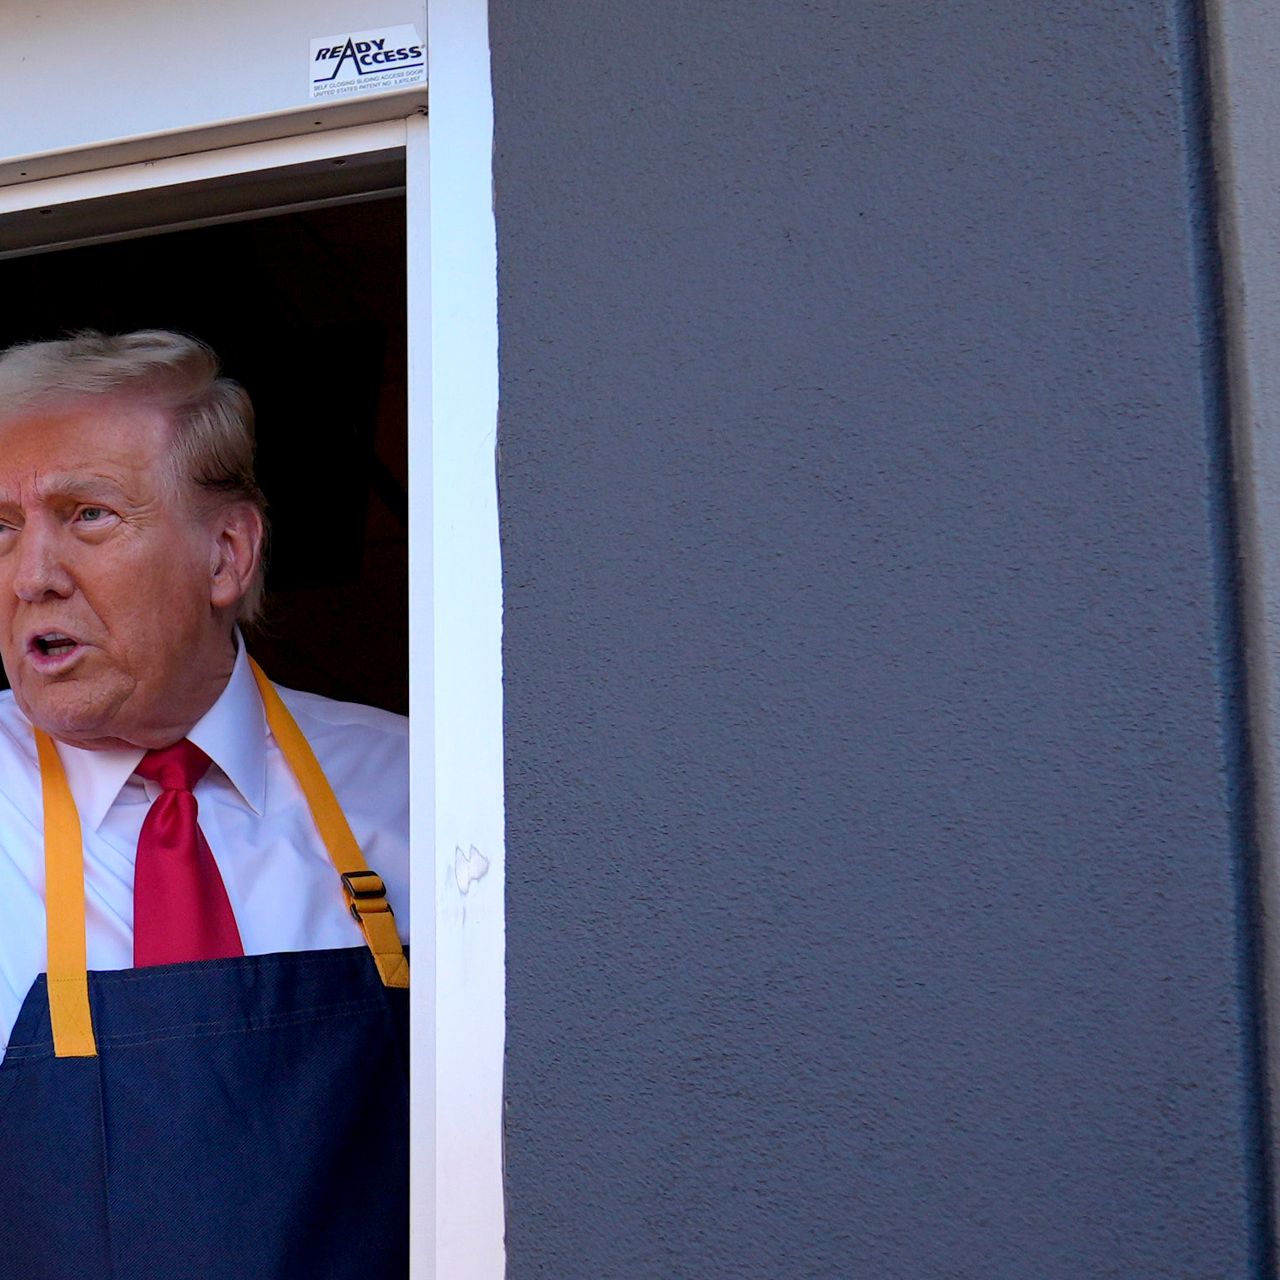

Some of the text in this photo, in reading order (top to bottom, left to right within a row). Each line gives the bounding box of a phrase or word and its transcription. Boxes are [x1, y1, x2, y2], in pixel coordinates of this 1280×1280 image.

[315, 38, 385, 66] READY
[381, 72, 405, 80] ACCESS
[313, 89, 335, 97] UNITED
[336, 86, 358, 94] STATES
[358, 82, 381, 90] PATENT
